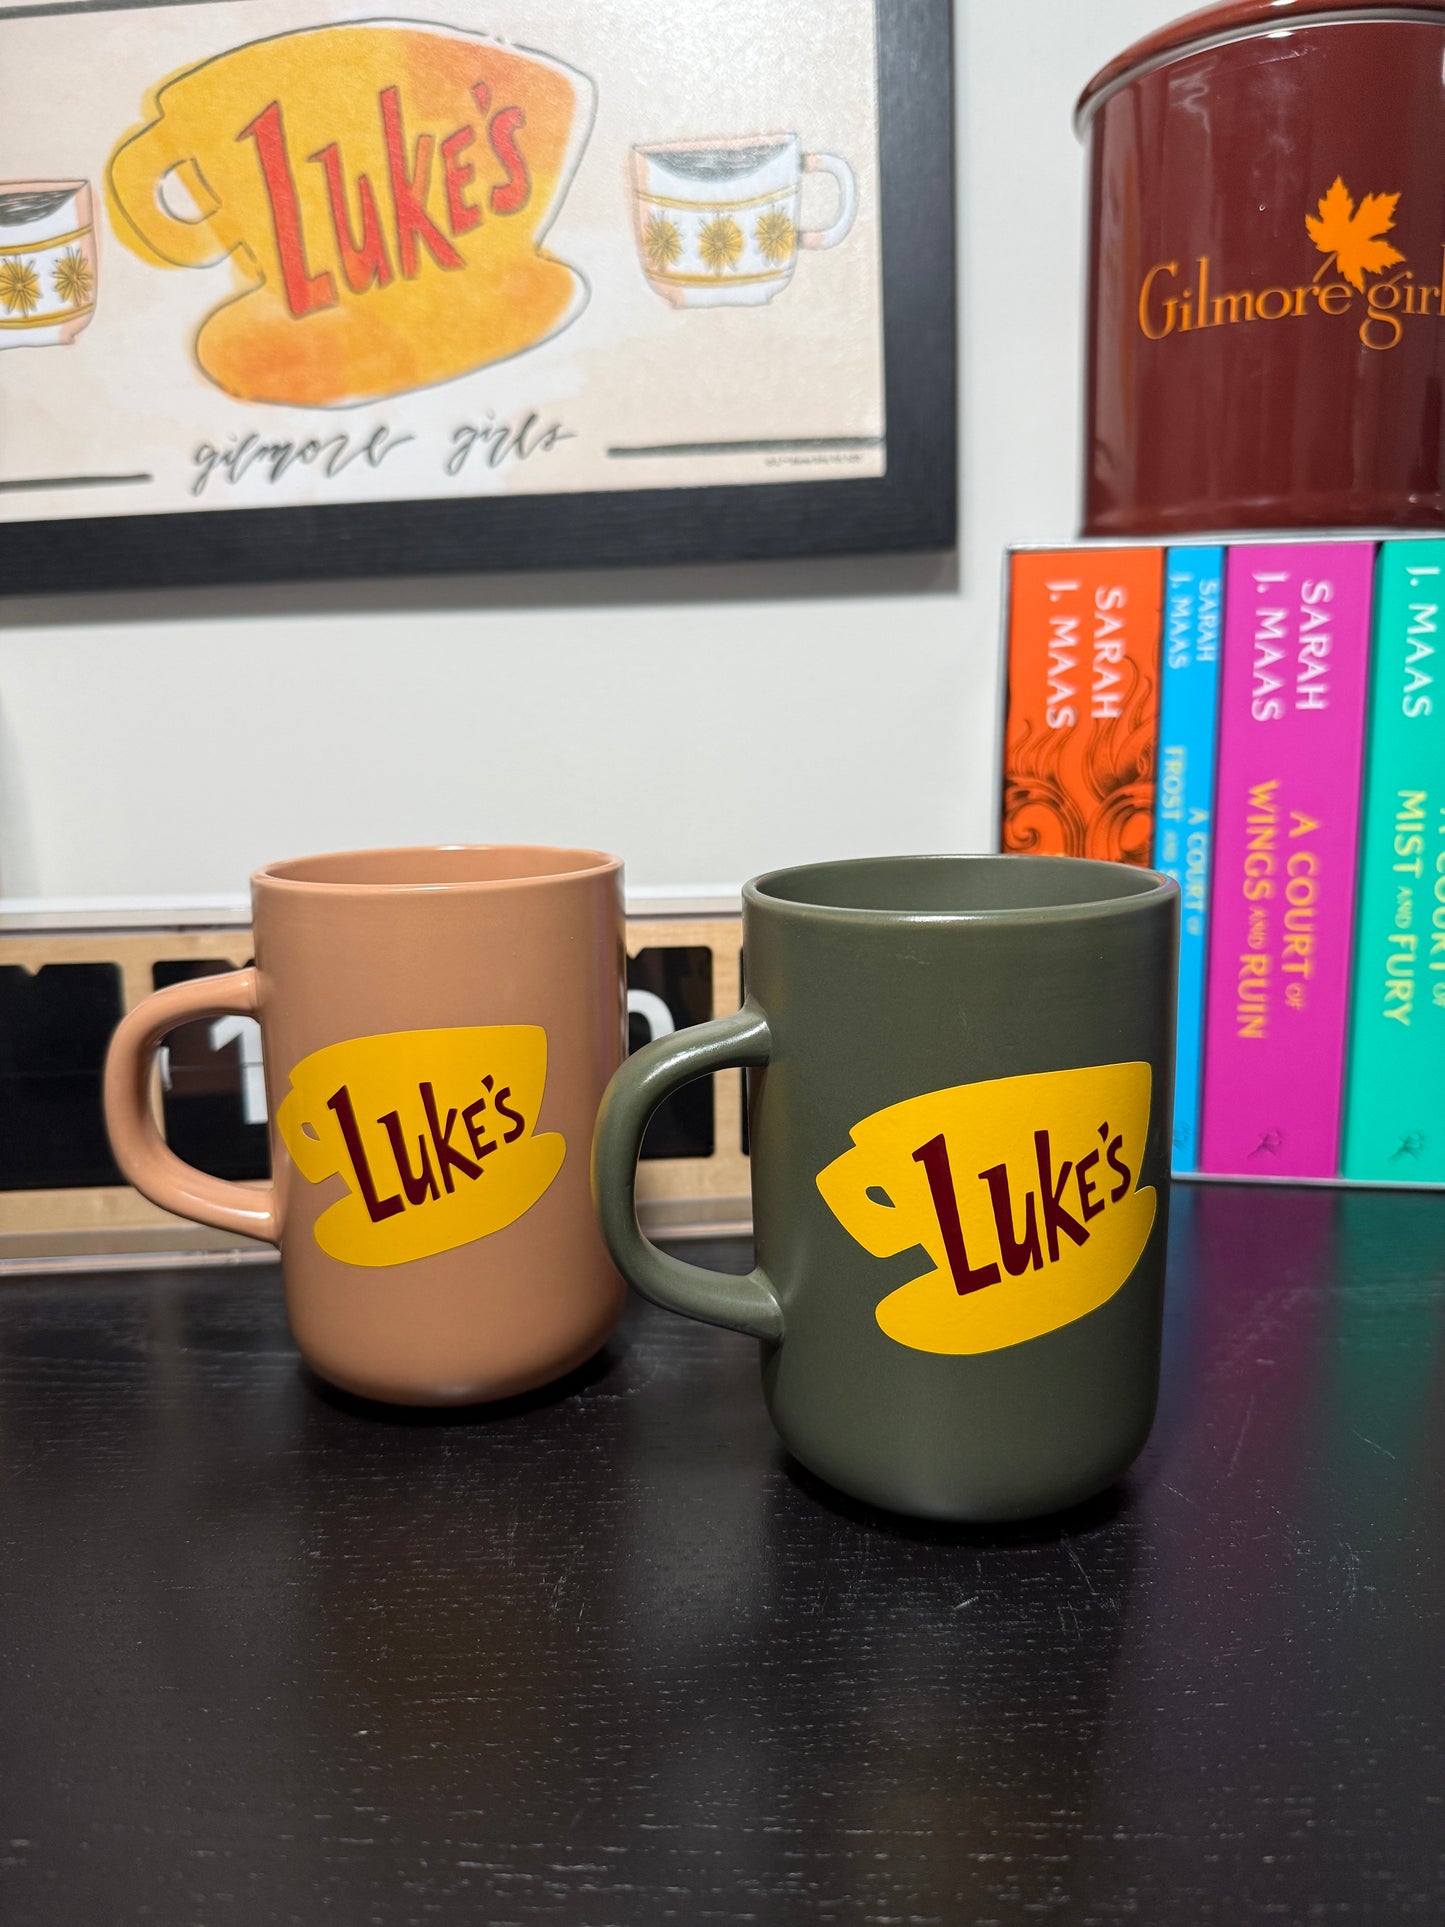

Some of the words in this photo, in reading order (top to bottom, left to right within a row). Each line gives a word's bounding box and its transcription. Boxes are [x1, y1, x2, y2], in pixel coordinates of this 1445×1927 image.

[1139, 256, 1352, 340] Gilmore
[191, 424, 416, 497] gilmore
[444, 410, 577, 476] girls
[1045, 579, 1082, 603] J.
[1252, 570, 1290, 594] J.
[1405, 566, 1441, 587] J.
[1091, 585, 1126, 719] SARAH
[1168, 596, 1192, 669] MAAS
[1196, 579, 1219, 661] SARAH
[1295, 579, 1333, 710] SARAH
[1402, 603, 1438, 718] MAAS
[1046, 616, 1082, 729] MAAS
[1252, 607, 1287, 721] MAAS
[1162, 745, 1185, 822] FROST
[1188, 807, 1209, 825] A
[1289, 812, 1320, 838] A
[1185, 832, 1208, 912] COURT
[1243, 779, 1281, 901] WINGS
[1392, 789, 1427, 879] MIST
[1247, 906, 1268, 949] AND
[1281, 851, 1318, 980] COURT
[1394, 886, 1413, 929] AND
[1237, 954, 1272, 1039] RUIN
[1383, 934, 1418, 1026] FURY
